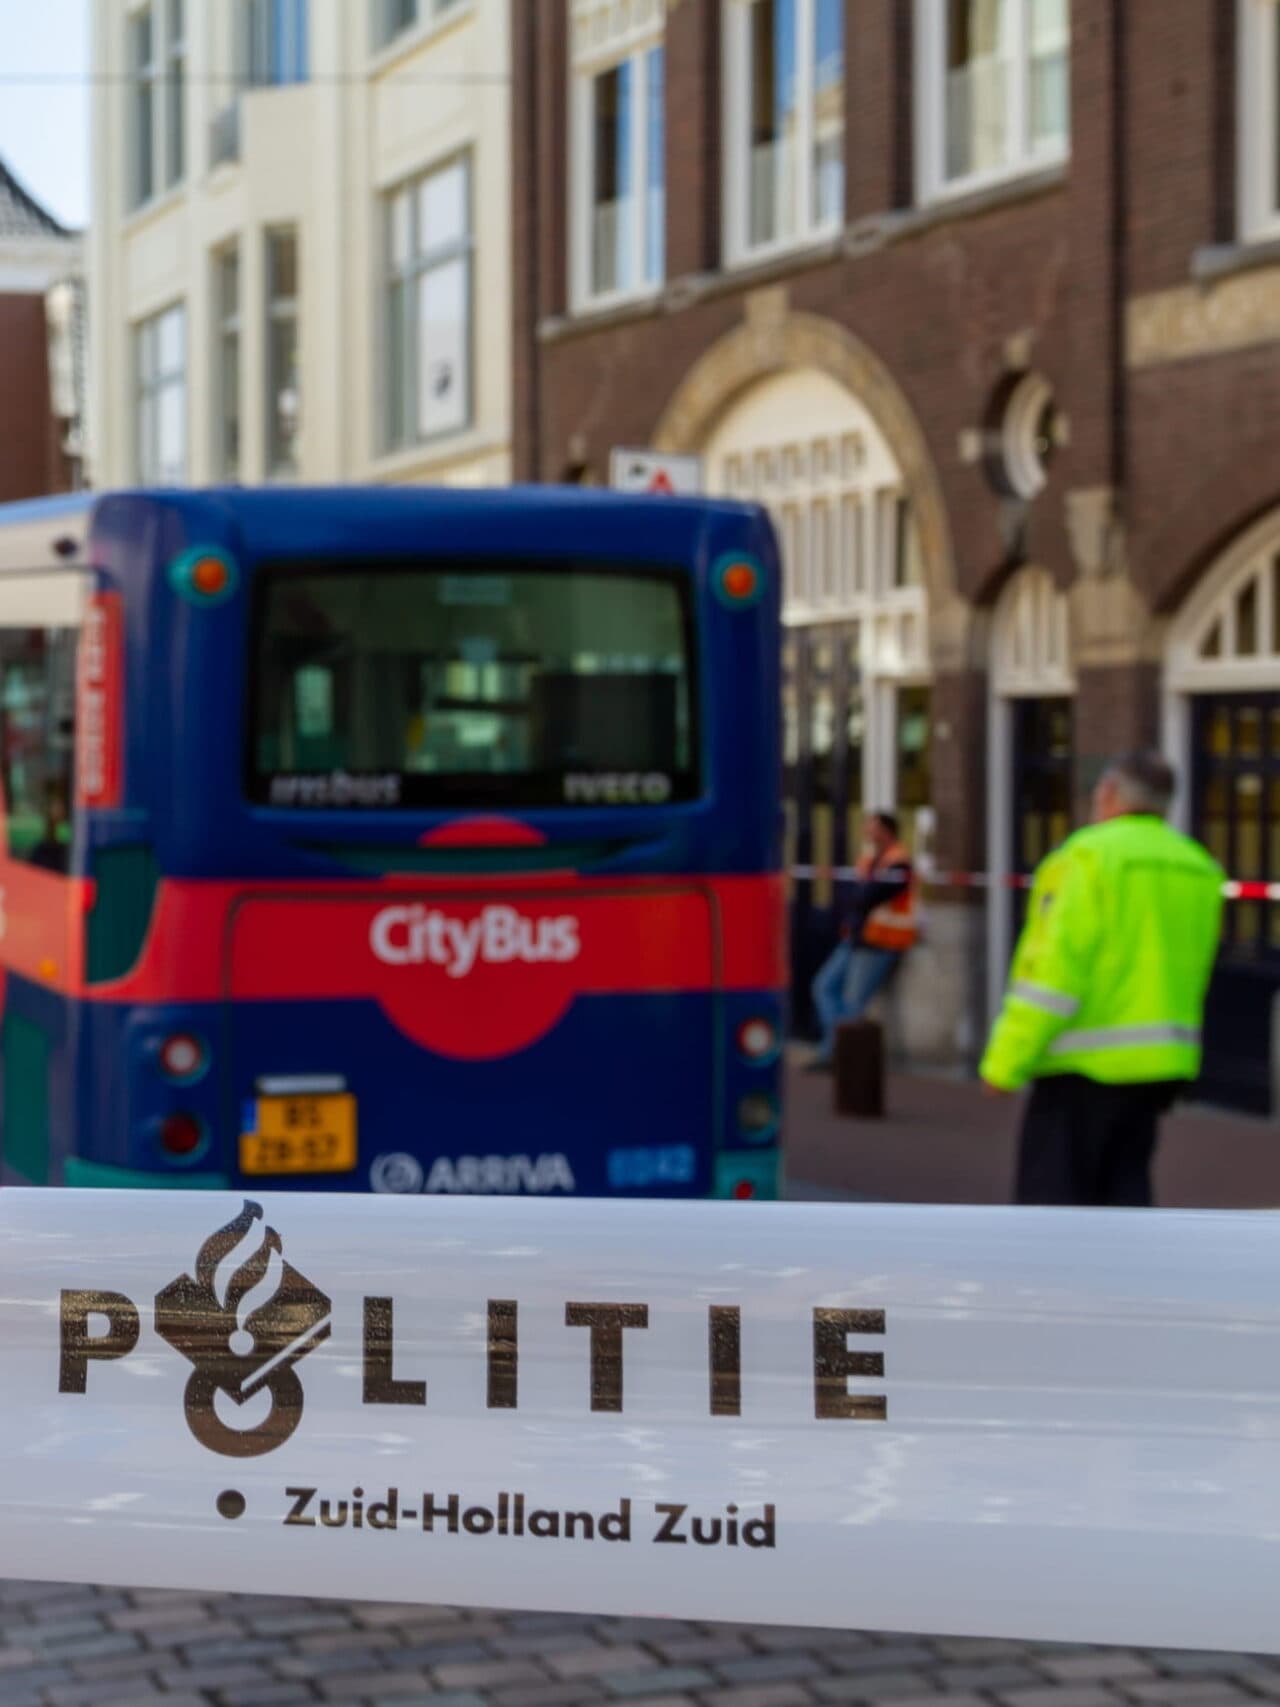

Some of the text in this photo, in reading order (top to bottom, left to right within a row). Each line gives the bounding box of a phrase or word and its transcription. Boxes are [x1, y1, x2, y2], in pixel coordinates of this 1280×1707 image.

[563, 772, 671, 801] IVECO
[370, 903, 580, 978] CityBus
[425, 1154, 575, 1191] ARRIVA
[282, 1487, 777, 1549] Zuid-Holland Zuid
